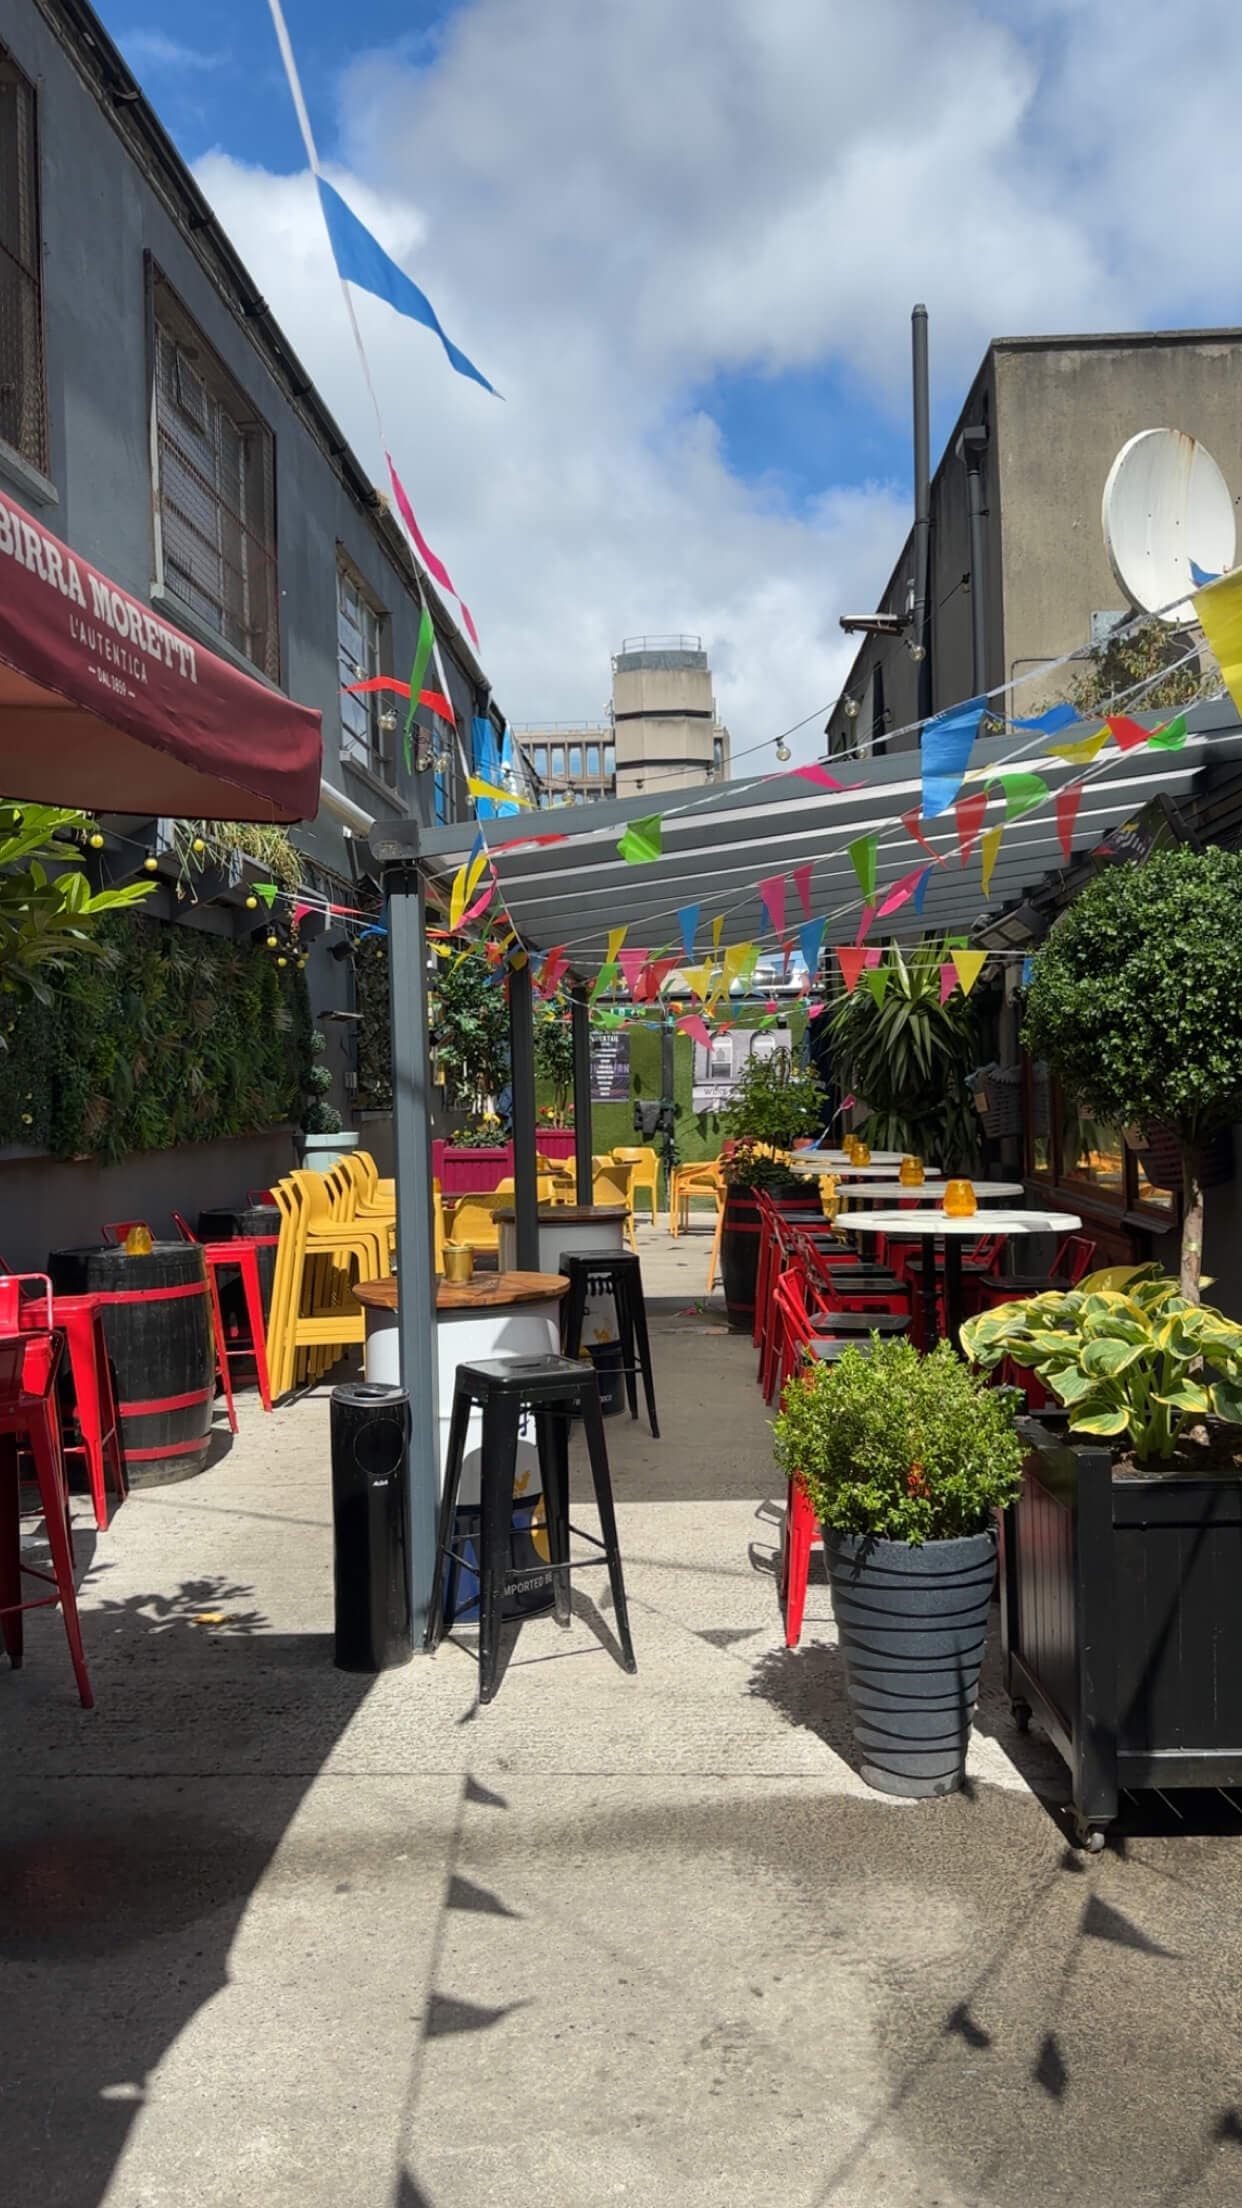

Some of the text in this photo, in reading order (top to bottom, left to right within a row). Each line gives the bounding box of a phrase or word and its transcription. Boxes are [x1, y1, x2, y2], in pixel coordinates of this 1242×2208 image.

[0, 503, 198, 684] BIRRA MORETTI
[69, 614, 148, 685] L'AUTENTICA
[503, 1575, 545, 1596] MPORTED
